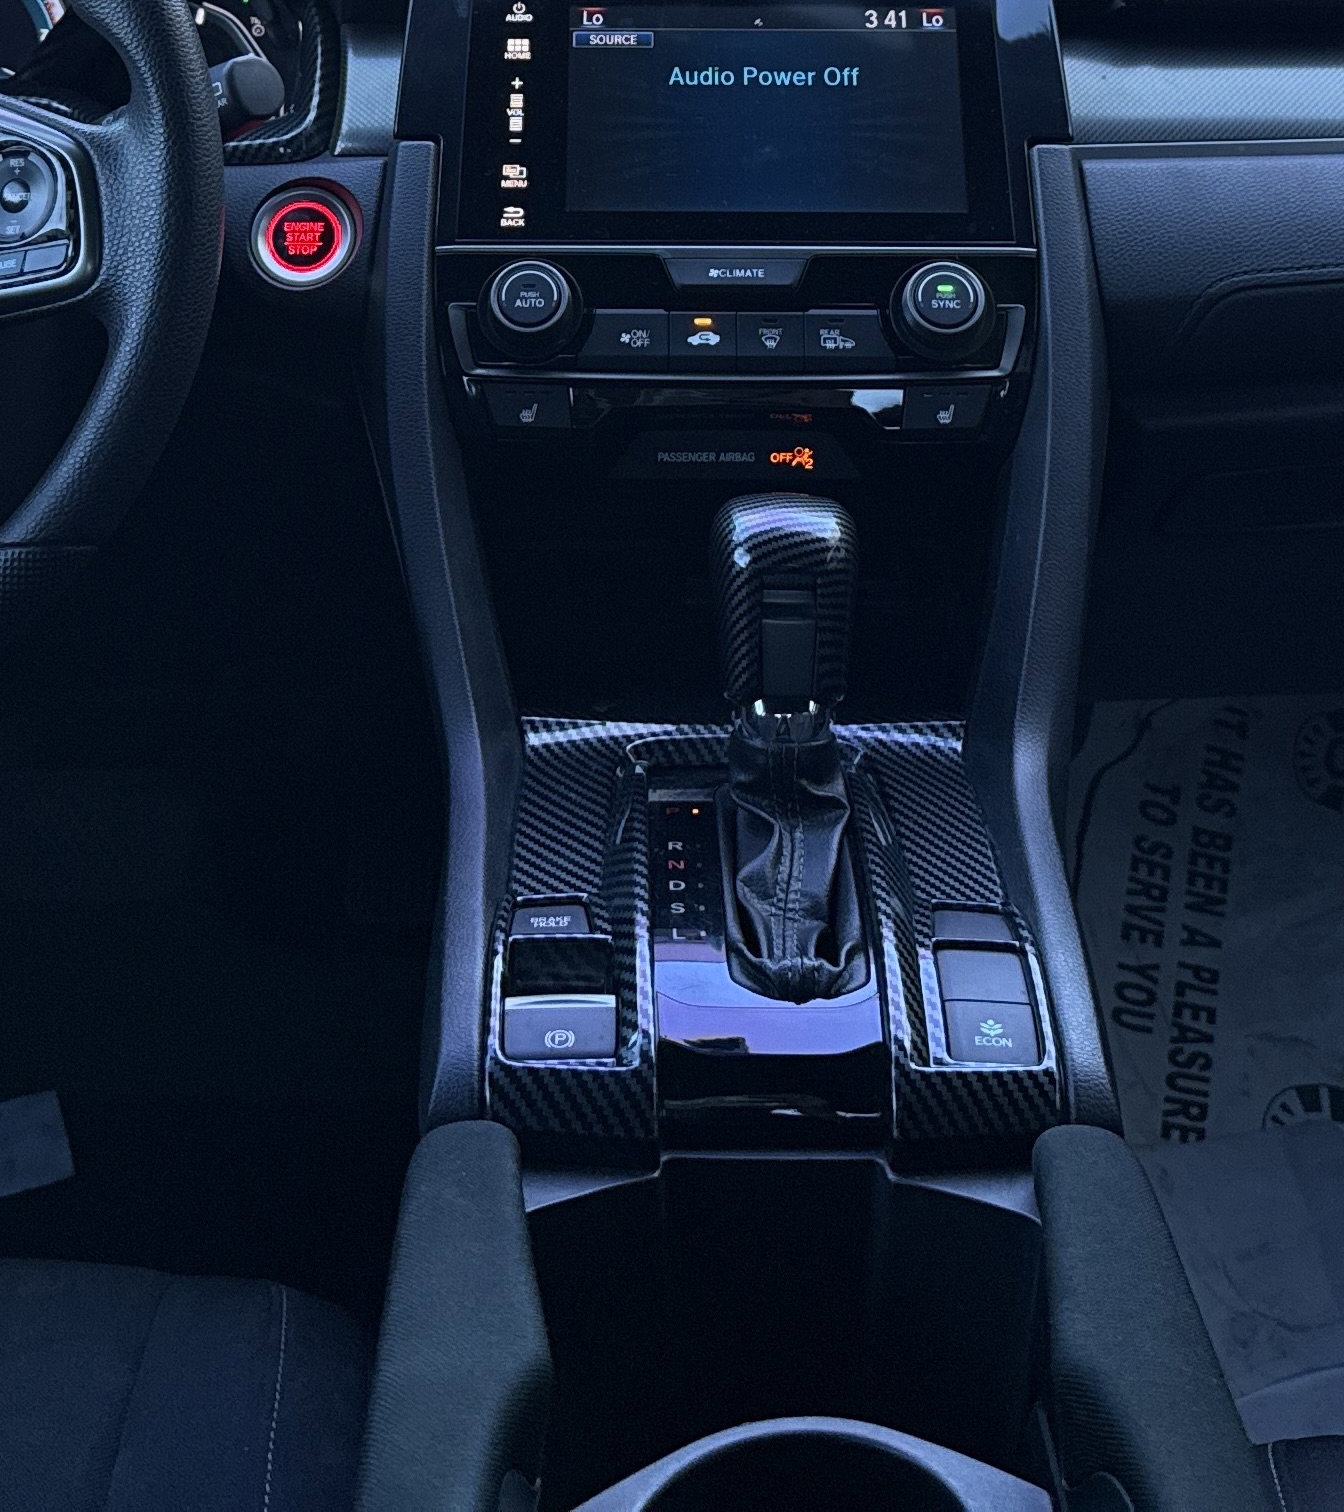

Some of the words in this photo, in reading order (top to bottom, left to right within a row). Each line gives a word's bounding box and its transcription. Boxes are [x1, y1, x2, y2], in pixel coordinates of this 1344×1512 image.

[505, 13, 533, 22] AUDIO
[582, 10, 604, 26] Lo
[922, 12, 944, 28] Lo
[589, 34, 638, 46] SOURCE
[504, 51, 531, 60] HOME
[668, 65, 736, 87] Audio
[743, 65, 817, 87] Power
[823, 65, 860, 87] Off
[506, 108, 524, 117] VOL
[9, 158, 25, 168] RES
[500, 179, 528, 188] MENU
[283, 221, 326, 232] ENGINE
[500, 218, 525, 228] BACK
[6, 224, 21, 235] SET
[285, 232, 322, 242] START
[287, 245, 318, 256] STOP
[718, 268, 766, 278] CLIMATE
[514, 298, 546, 308] AUTO
[931, 299, 961, 309] SYNC
[758, 327, 783, 335] FRONT
[819, 328, 841, 336] REAR
[630, 338, 651, 348] OFF
[657, 451, 716, 463] PASSENGER
[718, 451, 756, 463] AIRBAG
[769, 452, 793, 464] OFF
[1214, 704, 1251, 741] IT
[1194, 743, 1246, 820] HAS
[1137, 781, 1183, 829] TO
[667, 841, 684, 851] R
[667, 860, 685, 871] N
[1183, 823, 1235, 920] BEEN
[668, 880, 687, 891] D
[1120, 833, 1176, 950] SERVE
[670, 902, 686, 914] S
[530, 915, 572, 923] BRAKE
[672, 927, 687, 941] L
[1179, 923, 1224, 951] A
[1110, 960, 1161, 1036] YOU
[974, 1035, 1013, 1048] ECON
[1160, 960, 1222, 1147] PLEASURE
